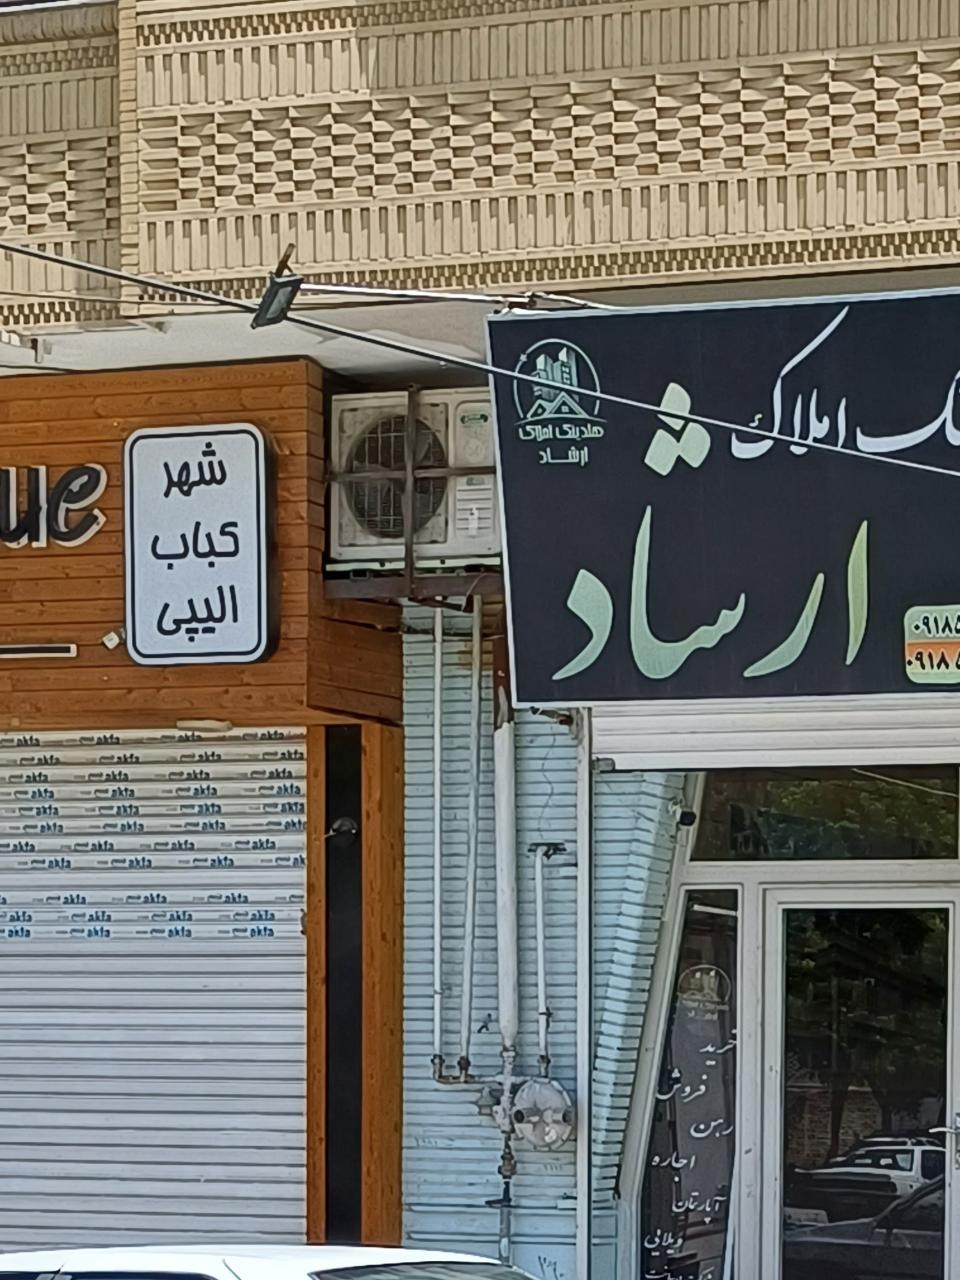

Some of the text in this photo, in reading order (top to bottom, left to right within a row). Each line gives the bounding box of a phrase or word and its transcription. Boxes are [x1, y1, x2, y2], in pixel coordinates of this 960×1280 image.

[731, 306, 849, 459] املاک
[163, 441, 228, 498] شهر
[539, 446, 589, 467] ارشاد
[151, 521, 239, 570] کباب
[552, 382, 869, 681] ارشاد
[157, 584, 239, 643] الیپی
[656, 1068, 706, 1103] فروش
[690, 1119, 734, 1138] رهن
[651, 1152, 696, 1182] اجاره
[672, 1191, 727, 1224] آپارتمان
